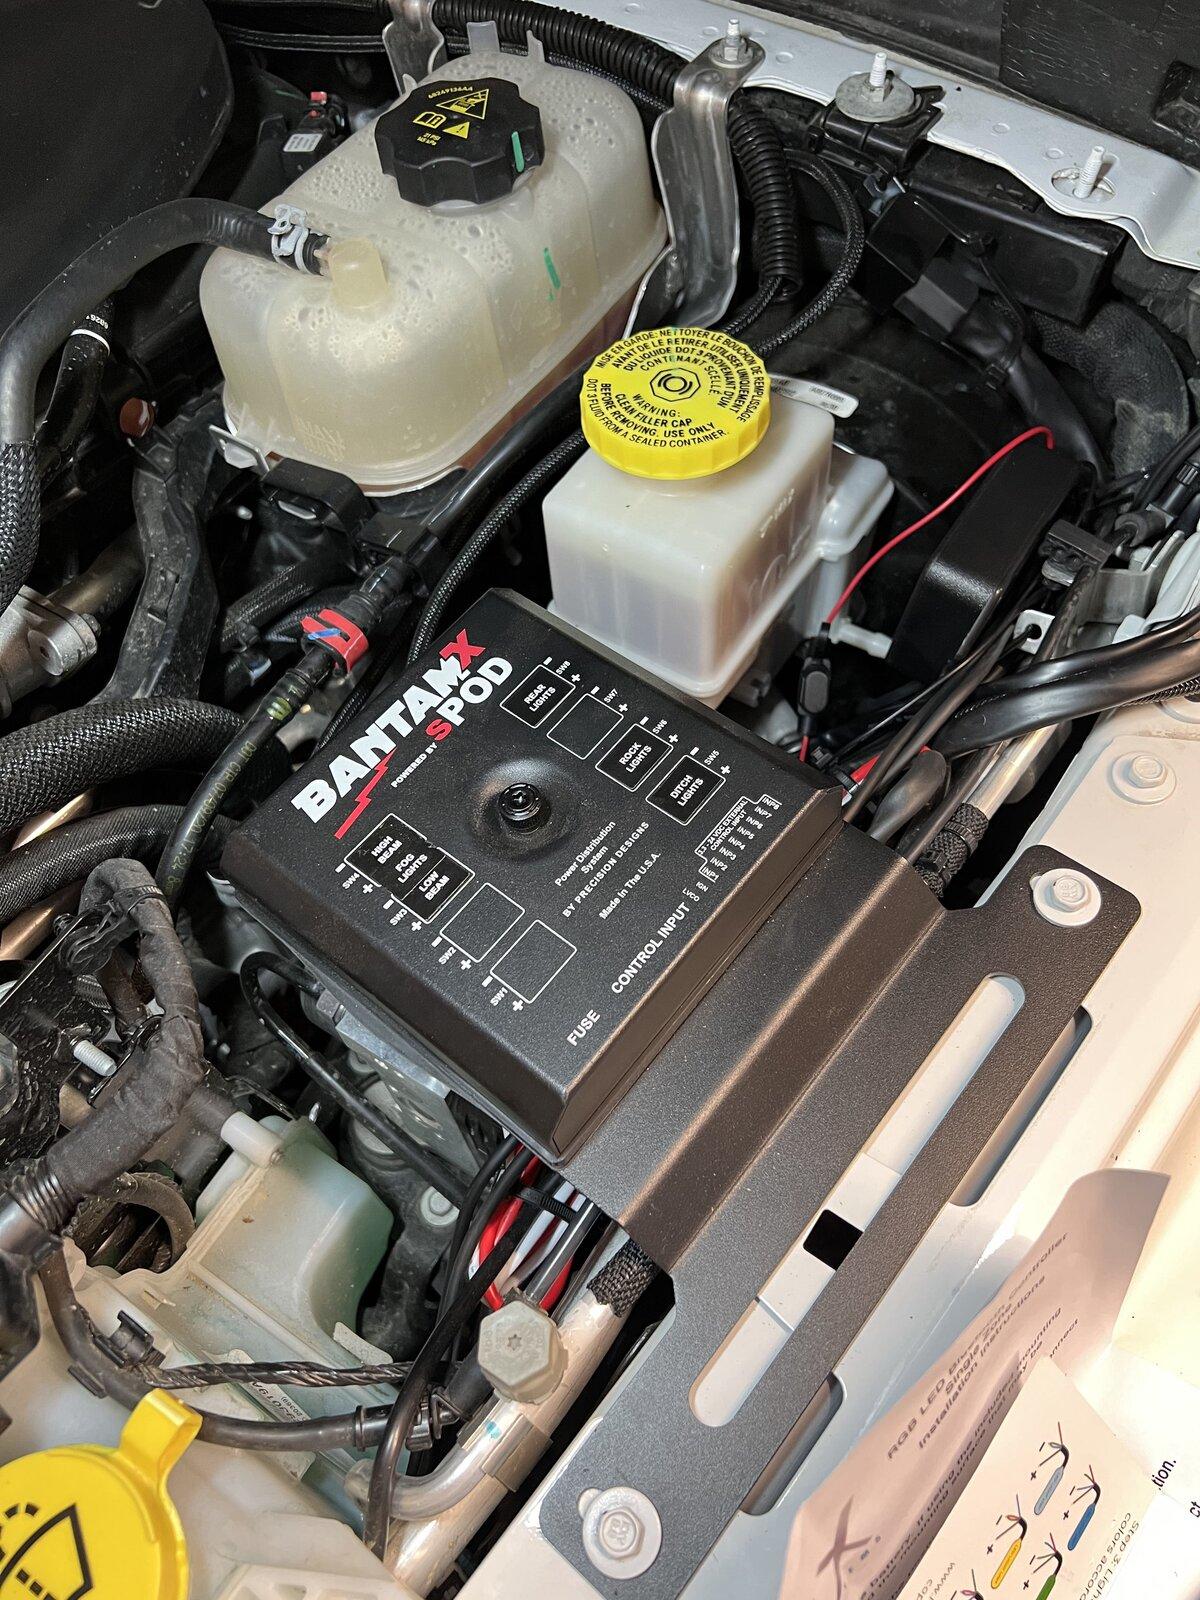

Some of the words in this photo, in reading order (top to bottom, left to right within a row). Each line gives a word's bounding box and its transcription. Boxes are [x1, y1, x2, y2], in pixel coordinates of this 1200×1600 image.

[623, 332, 658, 350] GARDE:
[660, 328, 710, 339] NETTOYER
[711, 333, 723, 342] LE
[595, 352, 614, 369] MISE
[611, 344, 625, 355] EN
[722, 339, 756, 366] BOUCHON
[623, 362, 638, 371] DU
[637, 347, 671, 364] LIQUIDE
[676, 346, 696, 354] DOT
[704, 352, 736, 390] PROVENANT
[640, 355, 707, 371] CONTENANT
[751, 366, 762, 375] DE
[586, 379, 599, 393] DOT
[612, 348, 638, 368] AVANT
[636, 343, 651, 352] DE
[651, 340, 664, 348] LE
[667, 338, 709, 350] RETIRER.
[710, 344, 743, 368] UTILISER
[730, 369, 749, 413] UNIQUEMENT
[588, 399, 604, 421] FLUID
[600, 383, 617, 411] BEFORE
[610, 410, 659, 437] REMOVING.
[663, 430, 685, 438] USE
[688, 422, 716, 436] ONLY
[615, 393, 637, 415] CLEAN
[634, 412, 668, 428] FILLER
[671, 418, 693, 428] CAP
[632, 394, 681, 418] WARNING:
[737, 377, 764, 422] REMPLISSAGE
[601, 416, 625, 434] FROM
[621, 431, 628, 439] A
[629, 434, 667, 448] SEALED
[556, 660, 571, 675] SW8
[524, 683, 547, 705] REAR
[529, 686, 557, 712] LIGHTS
[604, 688, 618, 703] SW7
[652, 719, 668, 735] SW6
[619, 742, 642, 765] ROCK
[625, 745, 652, 773] LIGHTS
[704, 750, 720, 766] SW5
[391, 753, 427, 788] POWERED
[425, 742, 438, 756] BY
[670, 775, 693, 799] DITCH
[677, 777, 704, 807] LIGHTS
[754, 806, 773, 819] INP7
[762, 797, 780, 810] INP8
[710, 826, 735, 851] CONTROL
[731, 809, 747, 827] INPUT
[713, 824, 726, 838] VDC
[724, 800, 748, 827] EXTERNAL
[745, 816, 763, 829] INP6
[728, 836, 746, 850] INP4
[736, 826, 755, 840] INP5
[371, 835, 393, 858] HIGH
[377, 839, 403, 864] BEAM
[555, 862, 579, 887] Power
[576, 821, 616, 863] Distribution
[719, 847, 737, 861] INP3
[395, 853, 415, 873] FOG
[398, 854, 428, 884] LIGHTS
[562, 903, 576, 918] BY
[574, 857, 617, 904] PRECISION
[615, 821, 649, 858] DESIGNS
[581, 846, 609, 874] System
[710, 857, 728, 871] INP2
[342, 873, 360, 890] SW4
[419, 871, 439, 893] LOW
[702, 867, 719, 880] INP1
[424, 875, 450, 901] BEAM
[599, 897, 621, 919] Made
[617, 889, 628, 898] In
[625, 874, 641, 889] The
[638, 852, 661, 875] U.S.A.
[682, 888, 700, 902] LVCO
[696, 882, 709, 892] IGN
[389, 908, 408, 926] SW3
[438, 947, 456, 965] SW2
[611, 933, 663, 994] CONTROL
[657, 901, 690, 940] INPUT
[490, 988, 508, 1006] SW1
[566, 1009, 601, 1046] FUSE
[945, 1344, 980, 1395] Single
[983, 1303, 1013, 1340] Zone
[1050, 1318, 1079, 1359] nnect
[1030, 1341, 1043, 1359] be
[918, 1362, 978, 1449] Installation
[980, 1275, 1046, 1357] Instructions
[887, 1418, 917, 1460] RGB
[919, 1378, 945, 1416] LED
[927, 1470, 955, 1512] using
[957, 1441, 973, 1465] the
[1017, 1307, 1061, 1372] mounting
[1152, 1460, 1177, 1491] tion.
[1107, 1513, 1131, 1554] colors
[1120, 1521, 1140, 1552] Step
